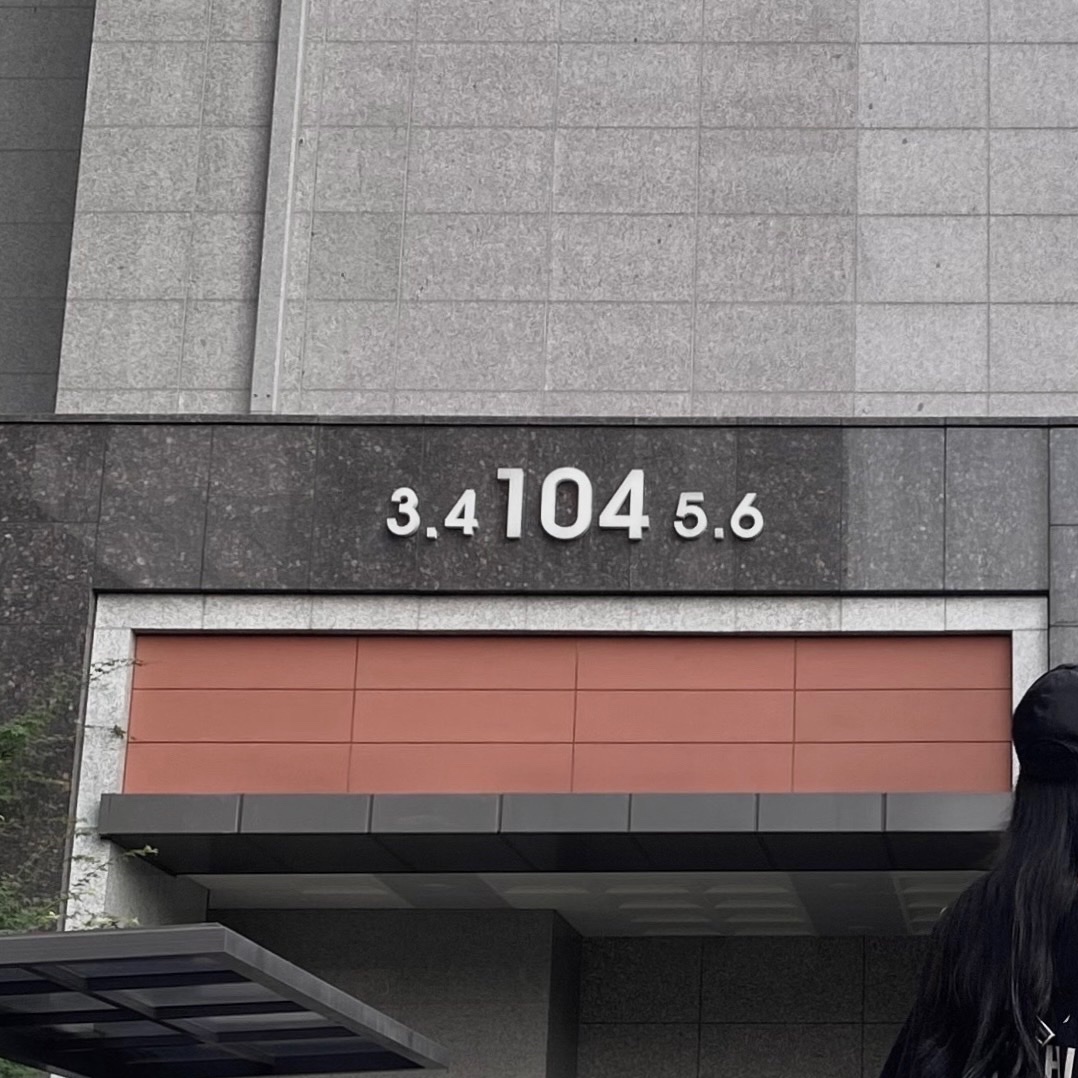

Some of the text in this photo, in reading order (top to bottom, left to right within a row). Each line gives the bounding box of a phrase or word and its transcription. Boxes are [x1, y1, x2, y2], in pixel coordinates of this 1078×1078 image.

[386, 467, 764, 540] 3.4 104 5.6
